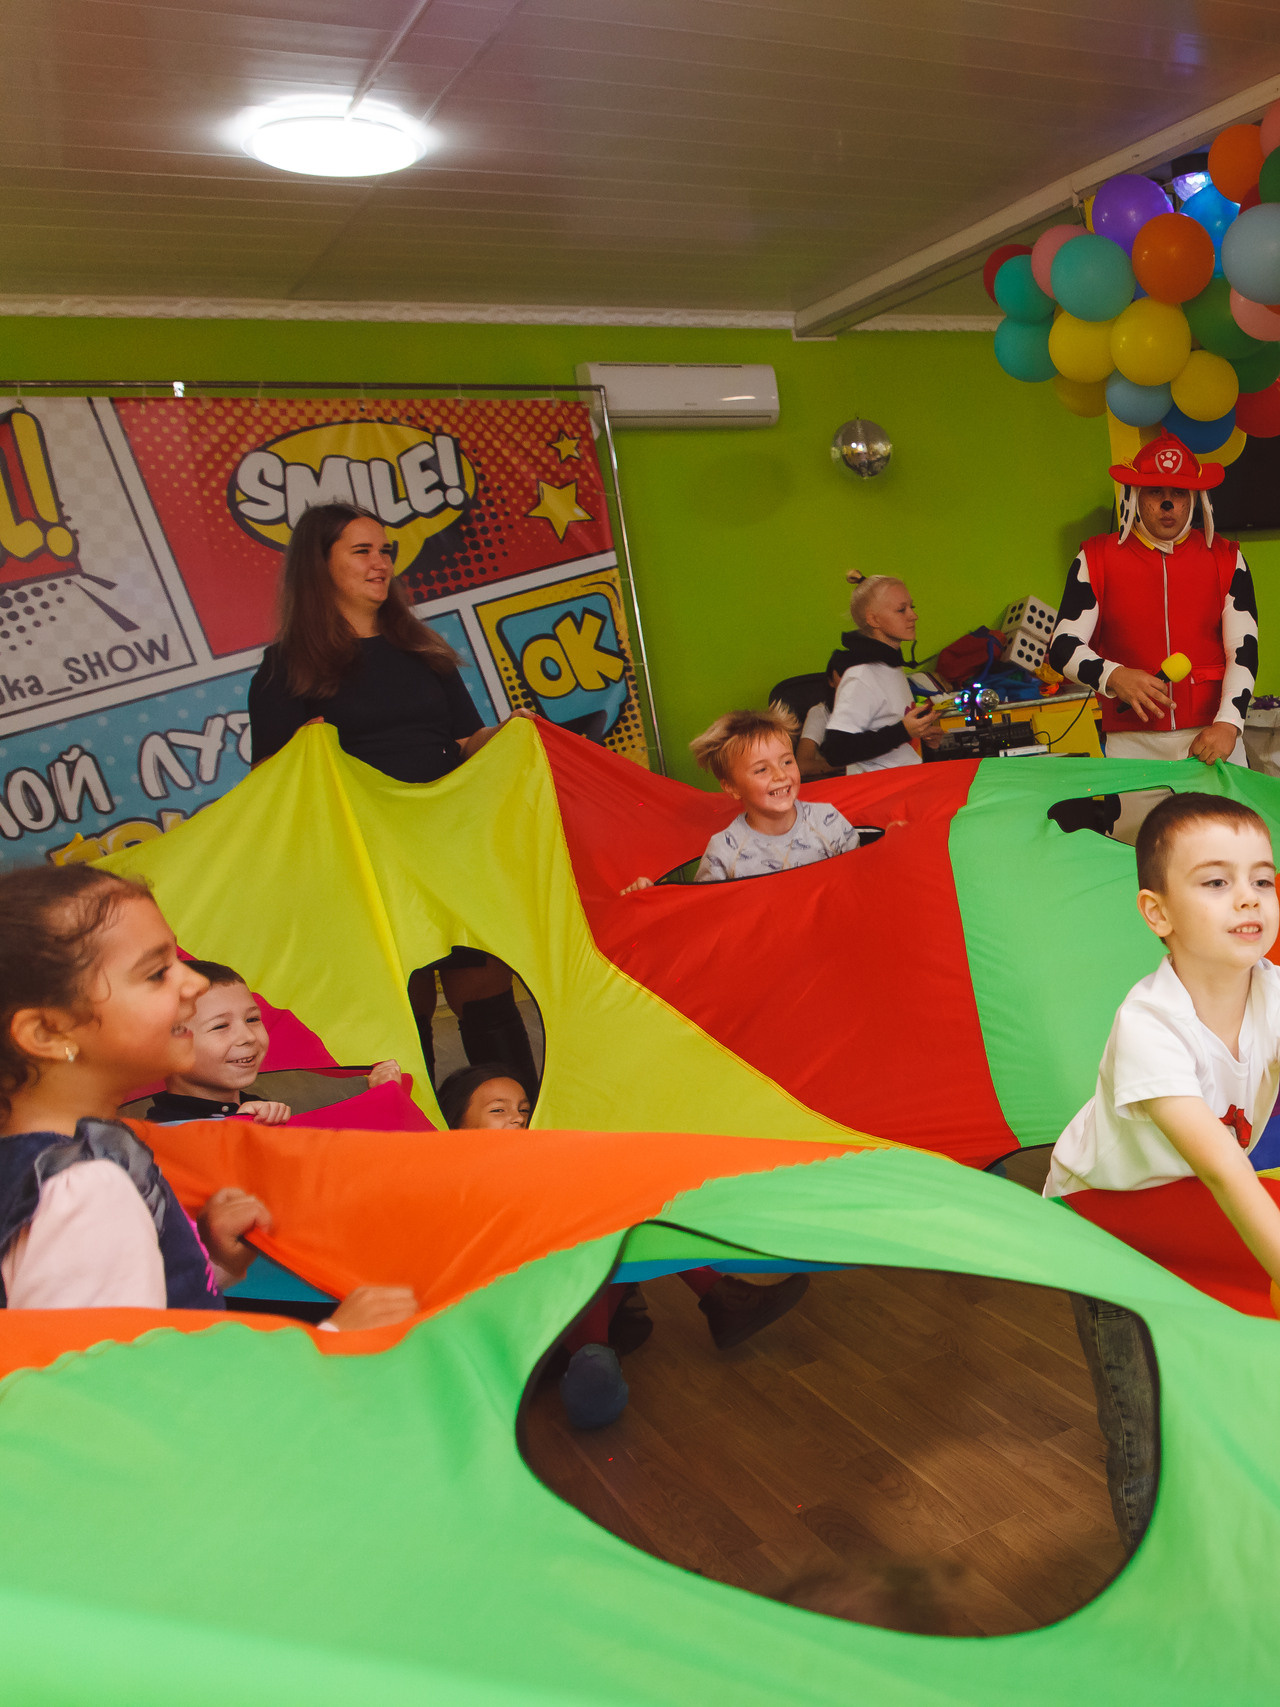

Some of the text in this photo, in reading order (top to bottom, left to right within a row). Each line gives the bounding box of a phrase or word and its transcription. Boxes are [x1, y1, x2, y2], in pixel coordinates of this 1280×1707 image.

[237, 434, 465, 530] SMILE!
[0, 633, 170, 704] ka_SHOW
[521, 610, 624, 698] OK
